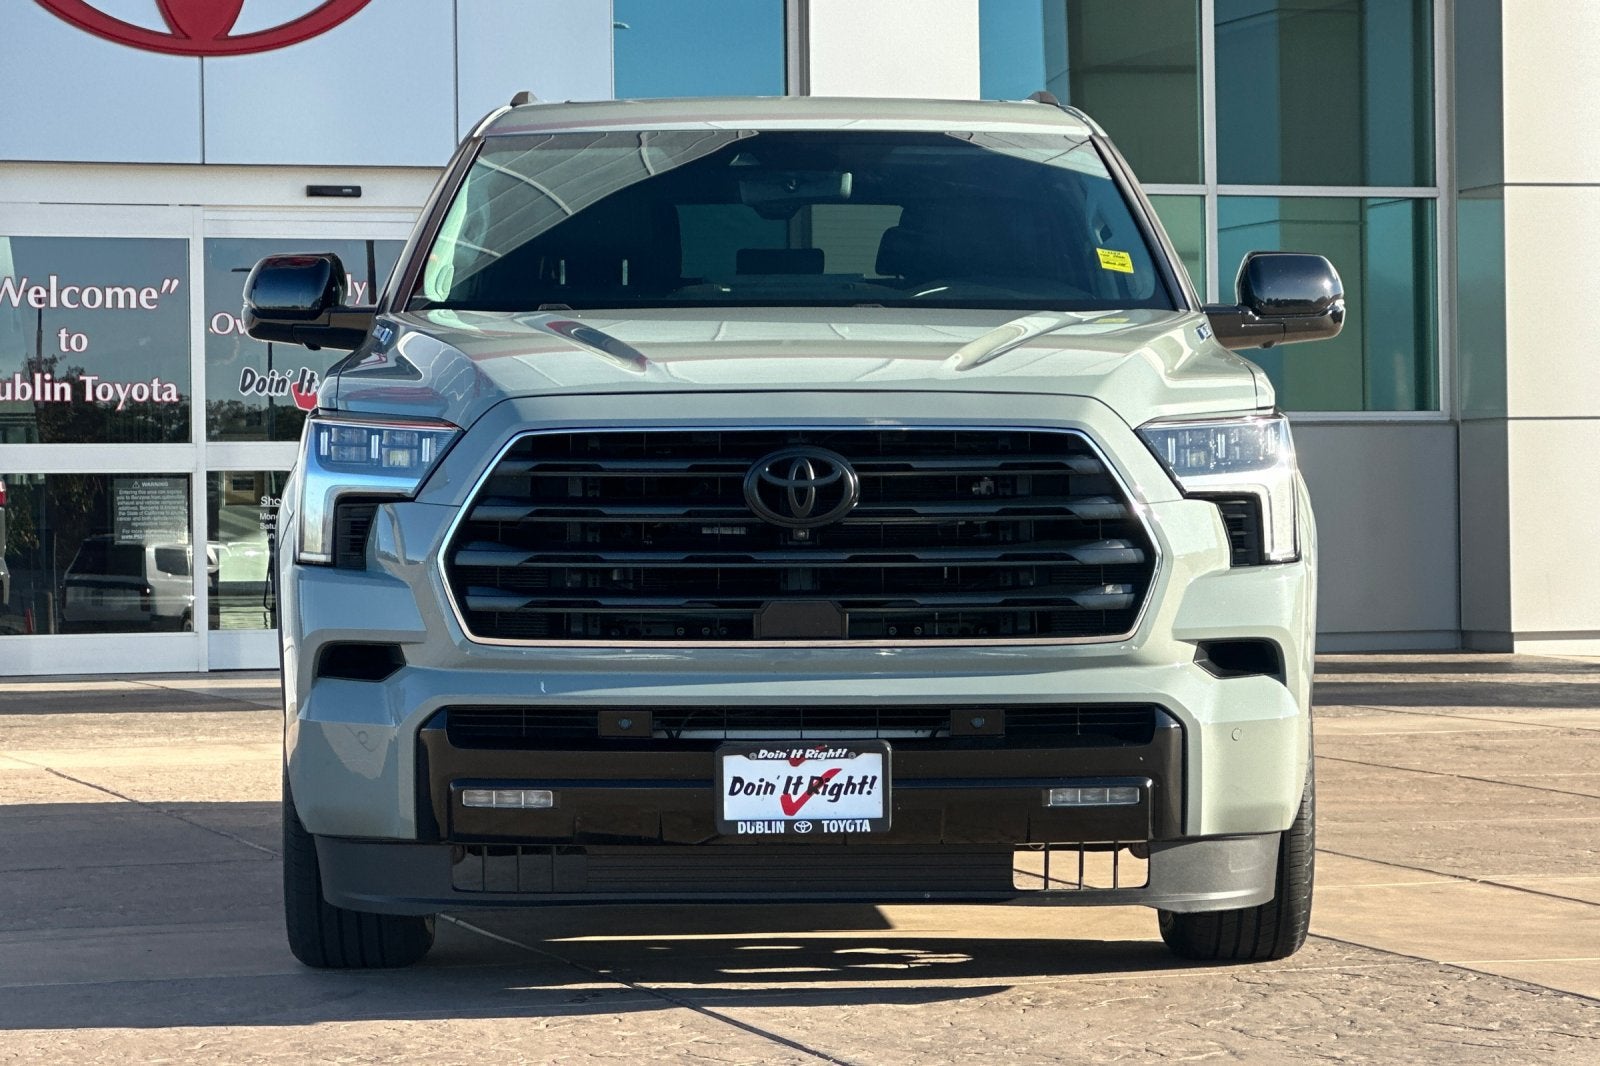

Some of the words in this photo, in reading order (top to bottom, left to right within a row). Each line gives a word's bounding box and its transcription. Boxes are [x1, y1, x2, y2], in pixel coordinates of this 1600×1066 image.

[345, 273, 367, 304] ly
[57, 327, 89, 352] to
[0, 373, 72, 401] ublin
[79, 375, 179, 411] Toyota
[239, 366, 293, 396] Doin'
[297, 367, 319, 396] It
[260, 495, 282, 507] Sho
[260, 512, 276, 521] Mon
[757, 749, 789, 759] Doin'
[790, 749, 803, 759] It
[805, 748, 848, 761] Right!
[728, 775, 780, 796] Doin'
[782, 776, 804, 796] It
[806, 775, 878, 802] Right!
[737, 820, 785, 834] DUBLIN
[821, 819, 871, 833] TOYOTA
